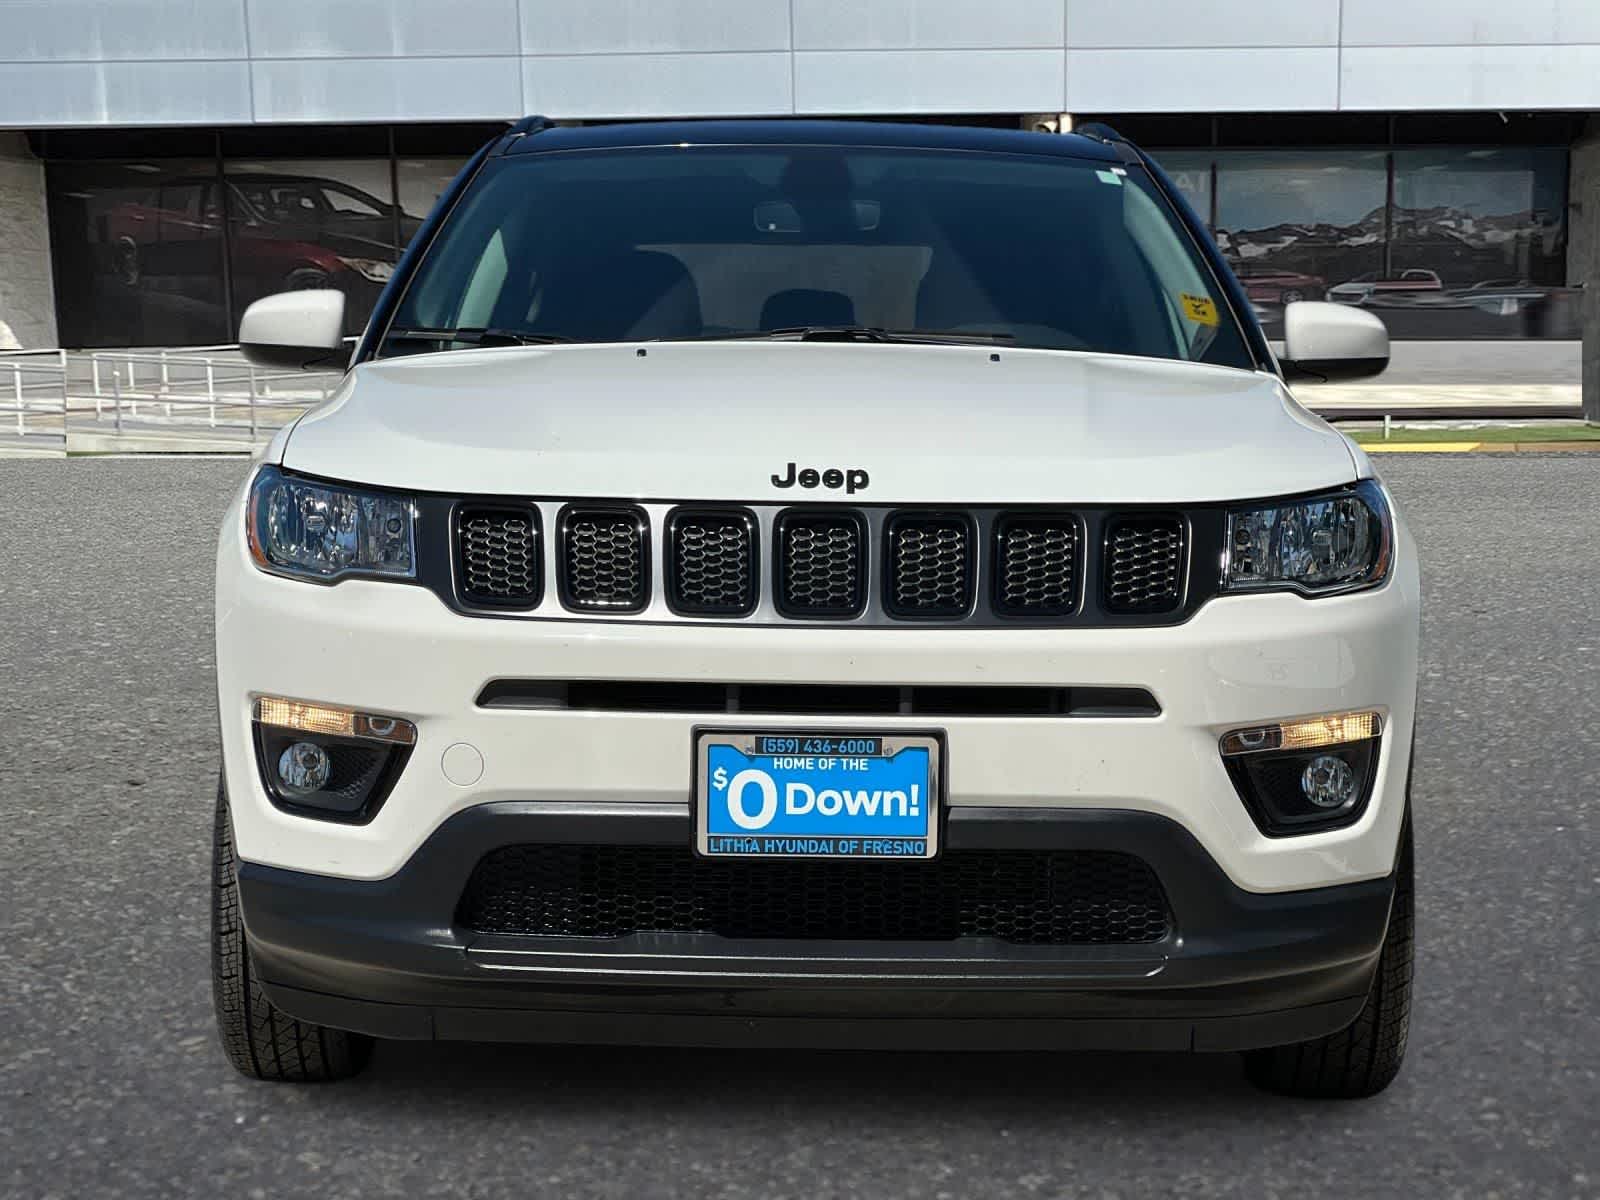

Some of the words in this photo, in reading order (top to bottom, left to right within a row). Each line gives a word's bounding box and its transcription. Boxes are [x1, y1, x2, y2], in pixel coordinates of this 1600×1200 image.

[771, 462, 869, 494] Jeep
[762, 738, 799, 754] (559)
[803, 739, 875, 753] 436-6000
[773, 757, 814, 769] HOME
[818, 758, 837, 769] OF
[841, 758, 869, 770] THE
[785, 782, 919, 817] Down!
[710, 838, 760, 852] LITHIA
[765, 839, 834, 853] HYUNDAI
[839, 840, 858, 853] OF
[863, 840, 924, 854] FRESNO
